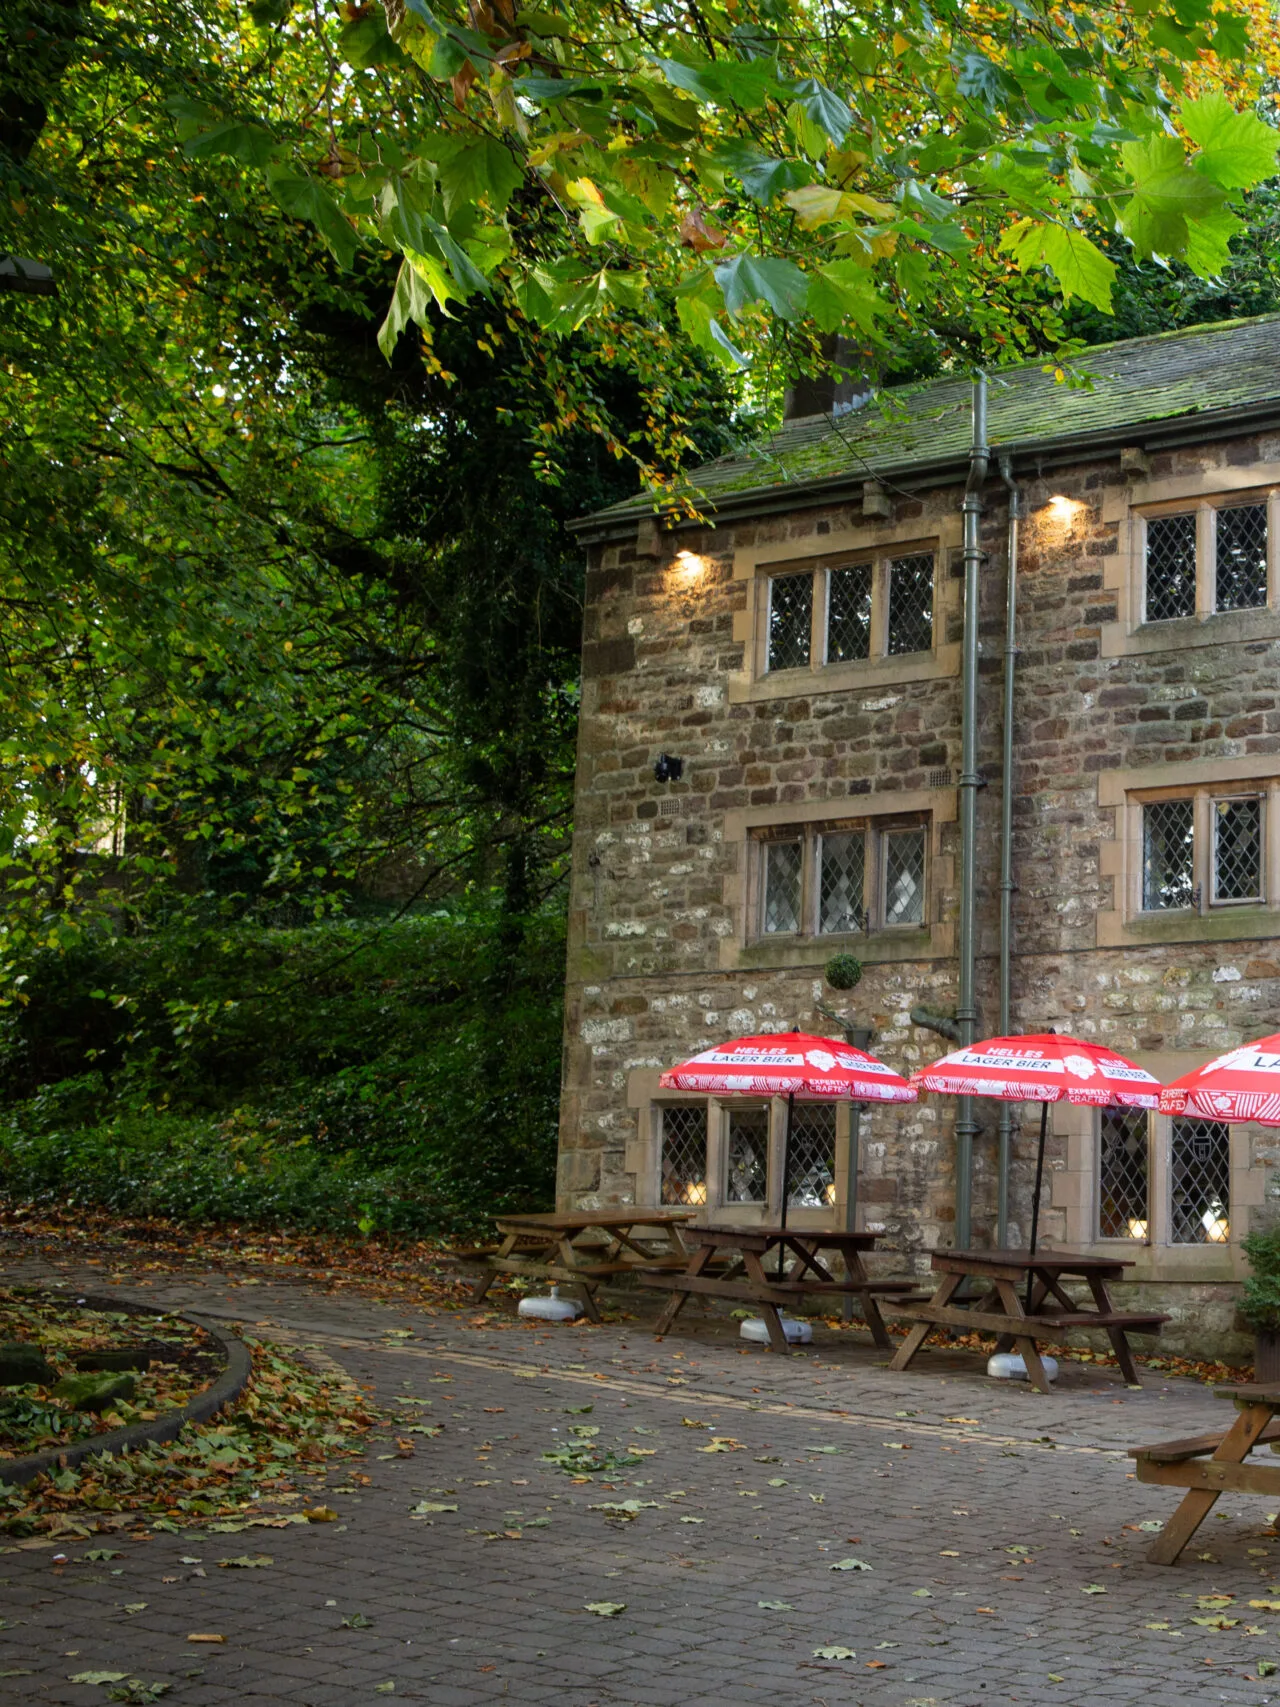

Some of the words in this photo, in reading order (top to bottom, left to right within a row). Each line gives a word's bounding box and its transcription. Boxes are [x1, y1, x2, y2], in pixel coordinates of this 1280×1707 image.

[734, 1047, 787, 1055] HELLES
[986, 1047, 1044, 1058] HELLES
[712, 1055, 760, 1063] LAGER
[763, 1055, 795, 1063] BIER
[962, 1055, 1012, 1067] LAGER
[1016, 1059, 1052, 1069] BIER
[809, 1078, 849, 1087] EXPERTLY
[1068, 1087, 1111, 1096] EXPERTLY
[1068, 1095, 1110, 1104] CRAFTED
